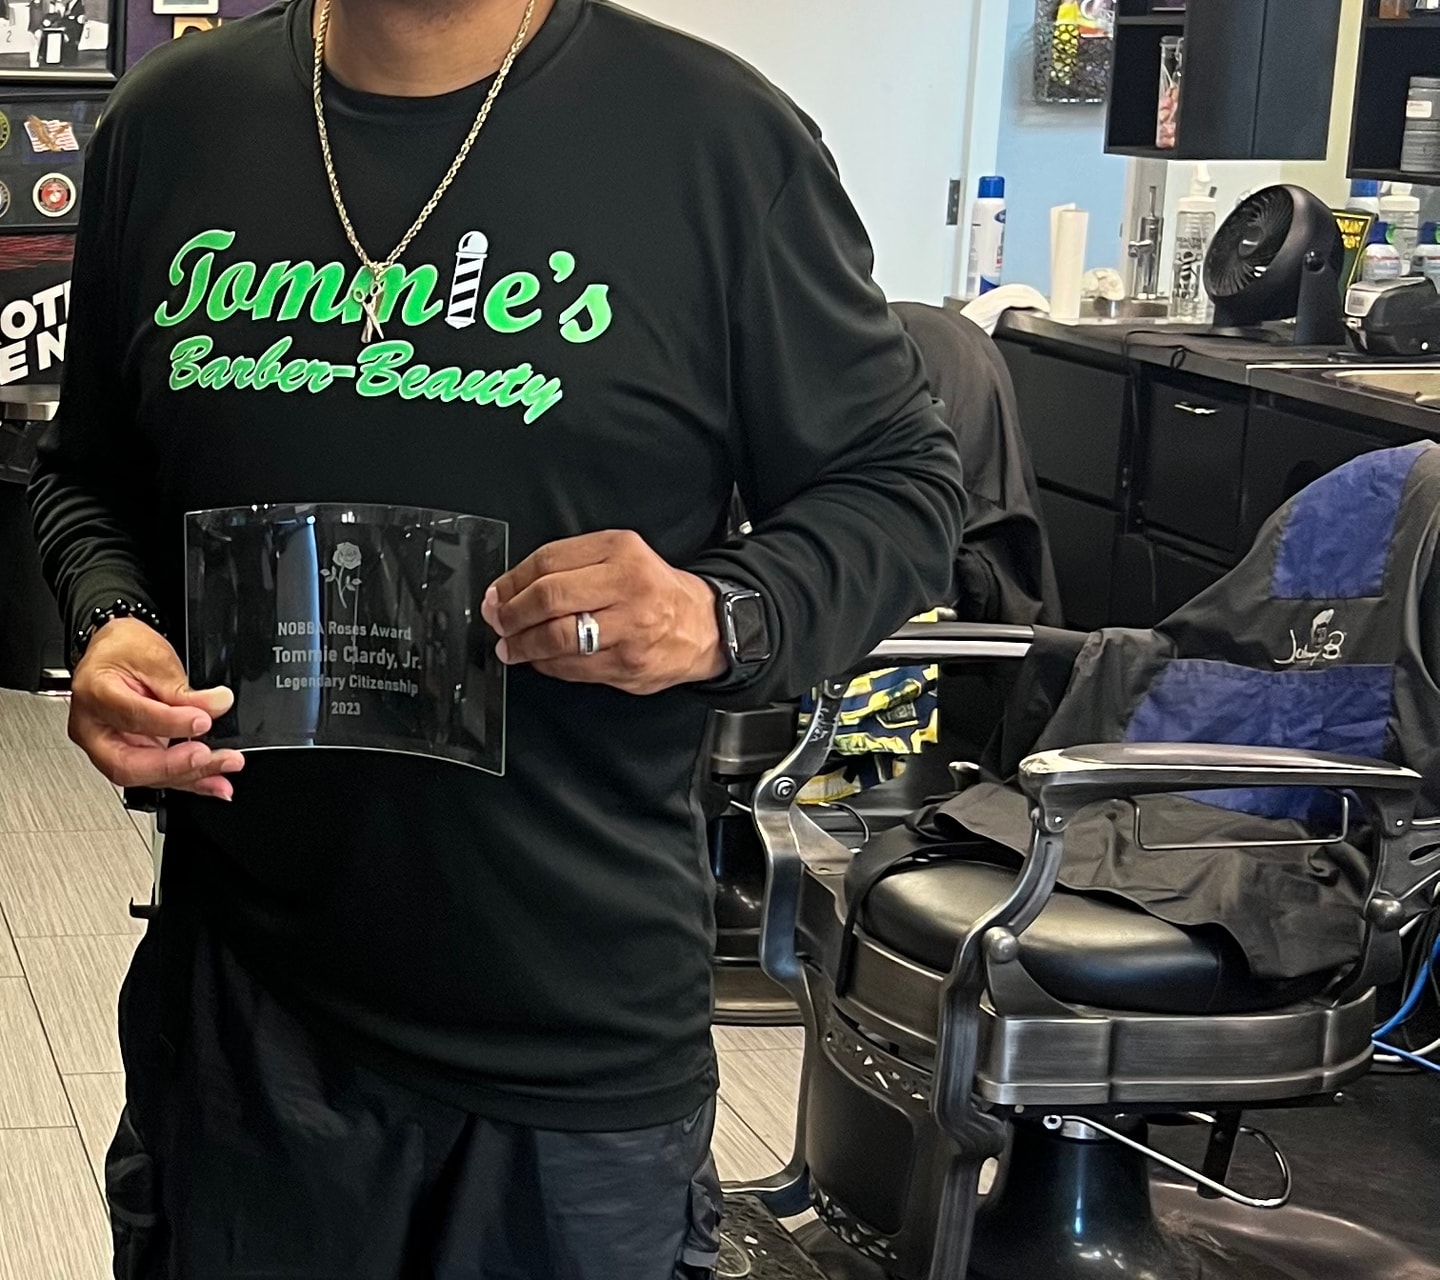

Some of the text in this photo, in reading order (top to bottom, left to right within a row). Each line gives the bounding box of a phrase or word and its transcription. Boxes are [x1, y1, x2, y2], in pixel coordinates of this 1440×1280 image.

[154, 228, 613, 345] Tommie's
[168, 336, 563, 425] Barber-Beauty
[277, 620, 412, 641] NOBBA Roses Award
[271, 645, 423, 670] Tommie Clardy, Jr.
[275, 674, 419, 698] Legendary Citizenship
[331, 701, 361, 716] 2023
